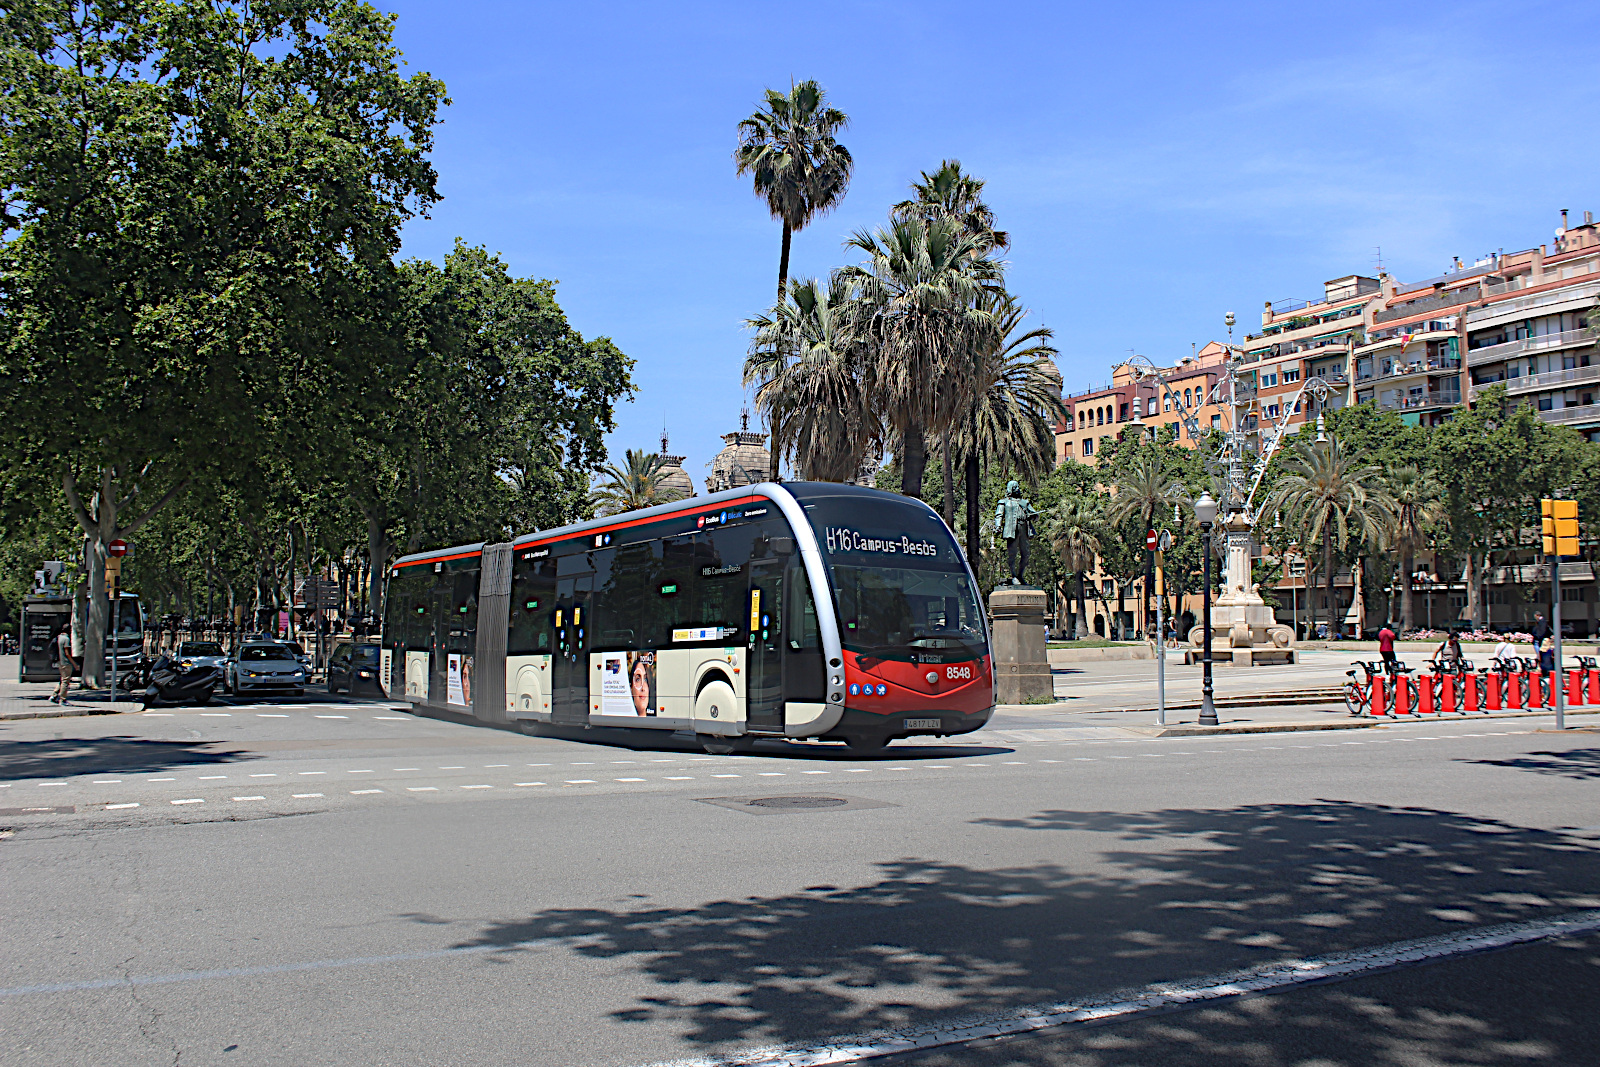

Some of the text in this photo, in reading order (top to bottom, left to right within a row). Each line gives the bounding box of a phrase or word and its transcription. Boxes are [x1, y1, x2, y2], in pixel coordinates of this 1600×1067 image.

[825, 527, 851, 551] H16
[946, 666, 971, 679] 8548
[908, 720, 926, 728] 4817
